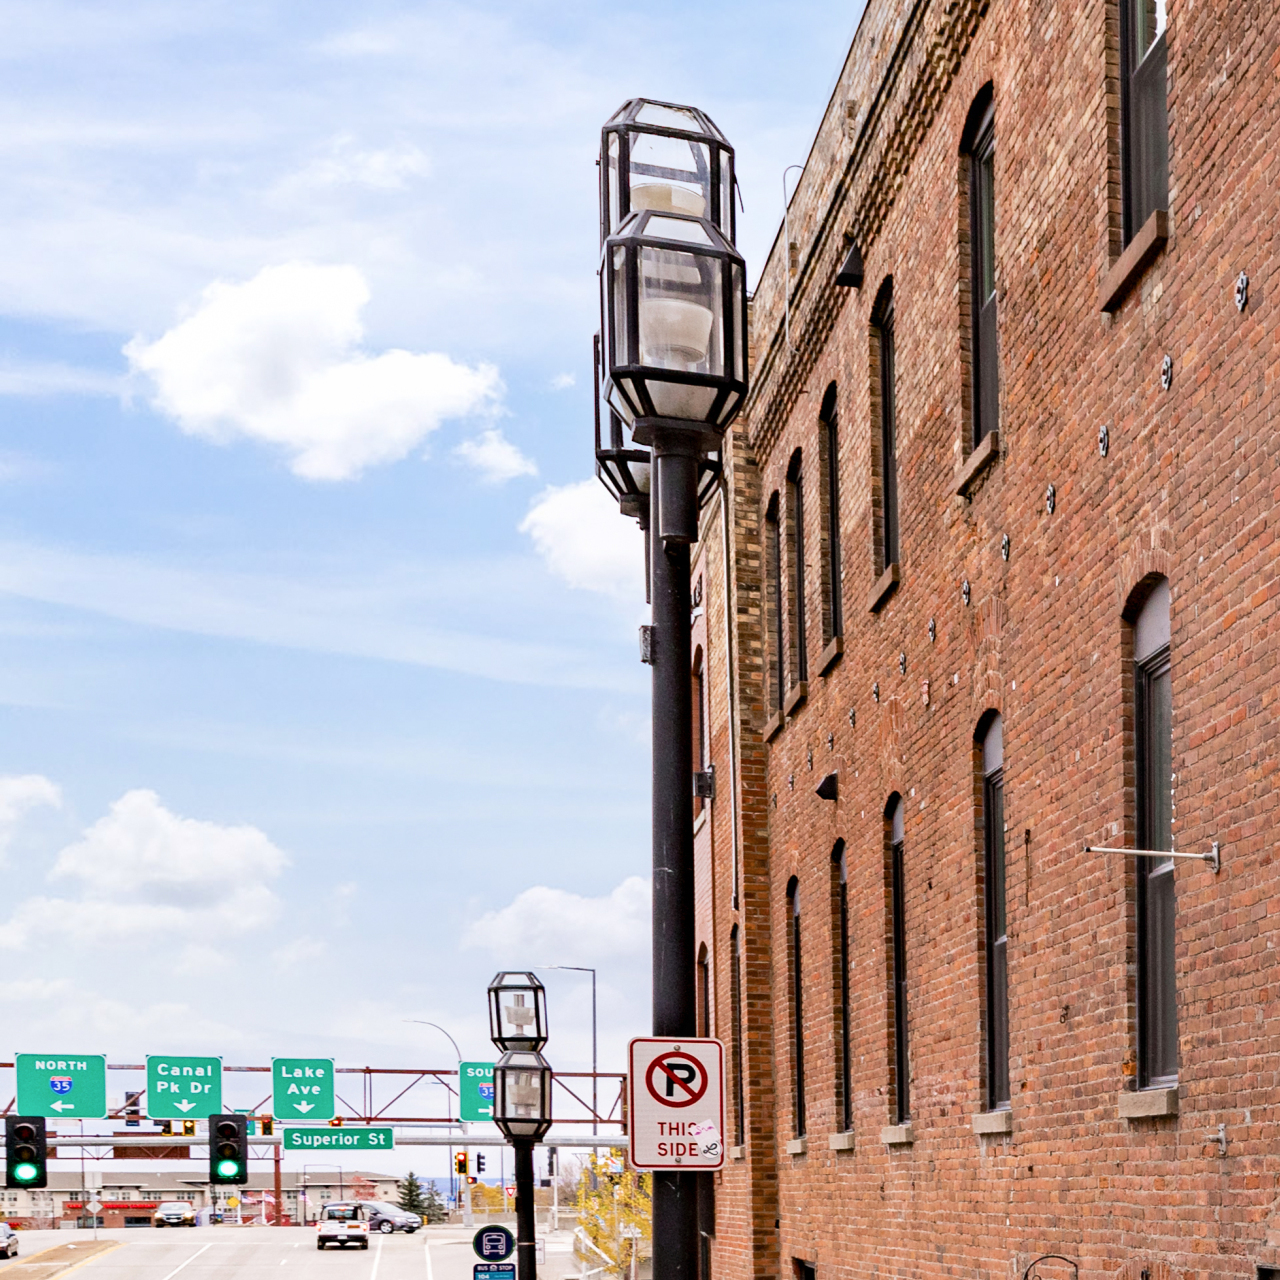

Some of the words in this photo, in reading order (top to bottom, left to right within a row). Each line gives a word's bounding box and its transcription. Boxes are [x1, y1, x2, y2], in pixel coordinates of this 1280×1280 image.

[35, 1060, 87, 1071] NORTH
[157, 1063, 212, 1077] Canal
[281, 1066, 325, 1078] Lake
[466, 1067, 494, 1077] SOU
[53, 1081, 71, 1091] 35
[157, 1081, 180, 1094] Pk
[190, 1081, 212, 1094] Dr
[286, 1083, 322, 1095] Ave
[291, 1133, 360, 1147] Superior
[368, 1133, 386, 1145] St
[657, 1142, 699, 1157] SIDE
